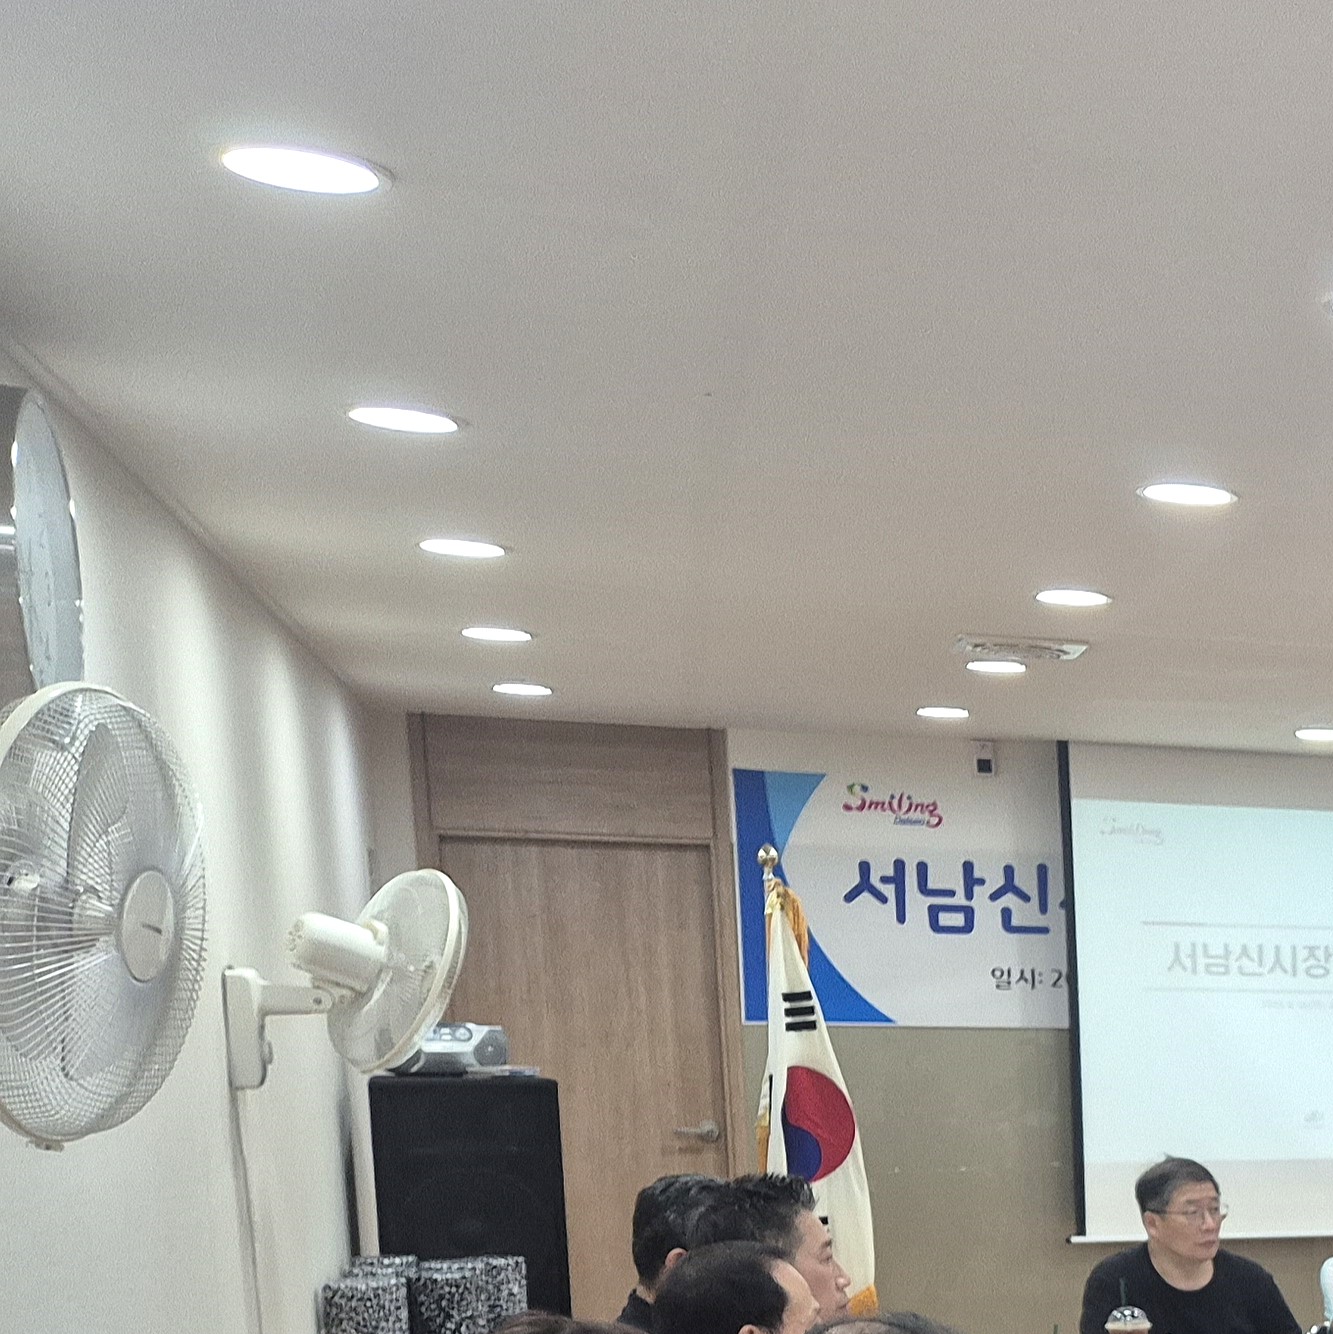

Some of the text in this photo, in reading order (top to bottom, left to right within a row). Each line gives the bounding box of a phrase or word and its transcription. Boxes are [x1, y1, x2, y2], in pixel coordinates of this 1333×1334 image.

[842, 783, 943, 828] Smiling
[842, 858, 1067, 935] 서남신
[990, 967, 1068, 990] 일시: 2
[1166, 941, 1332, 980] 서남신시장
